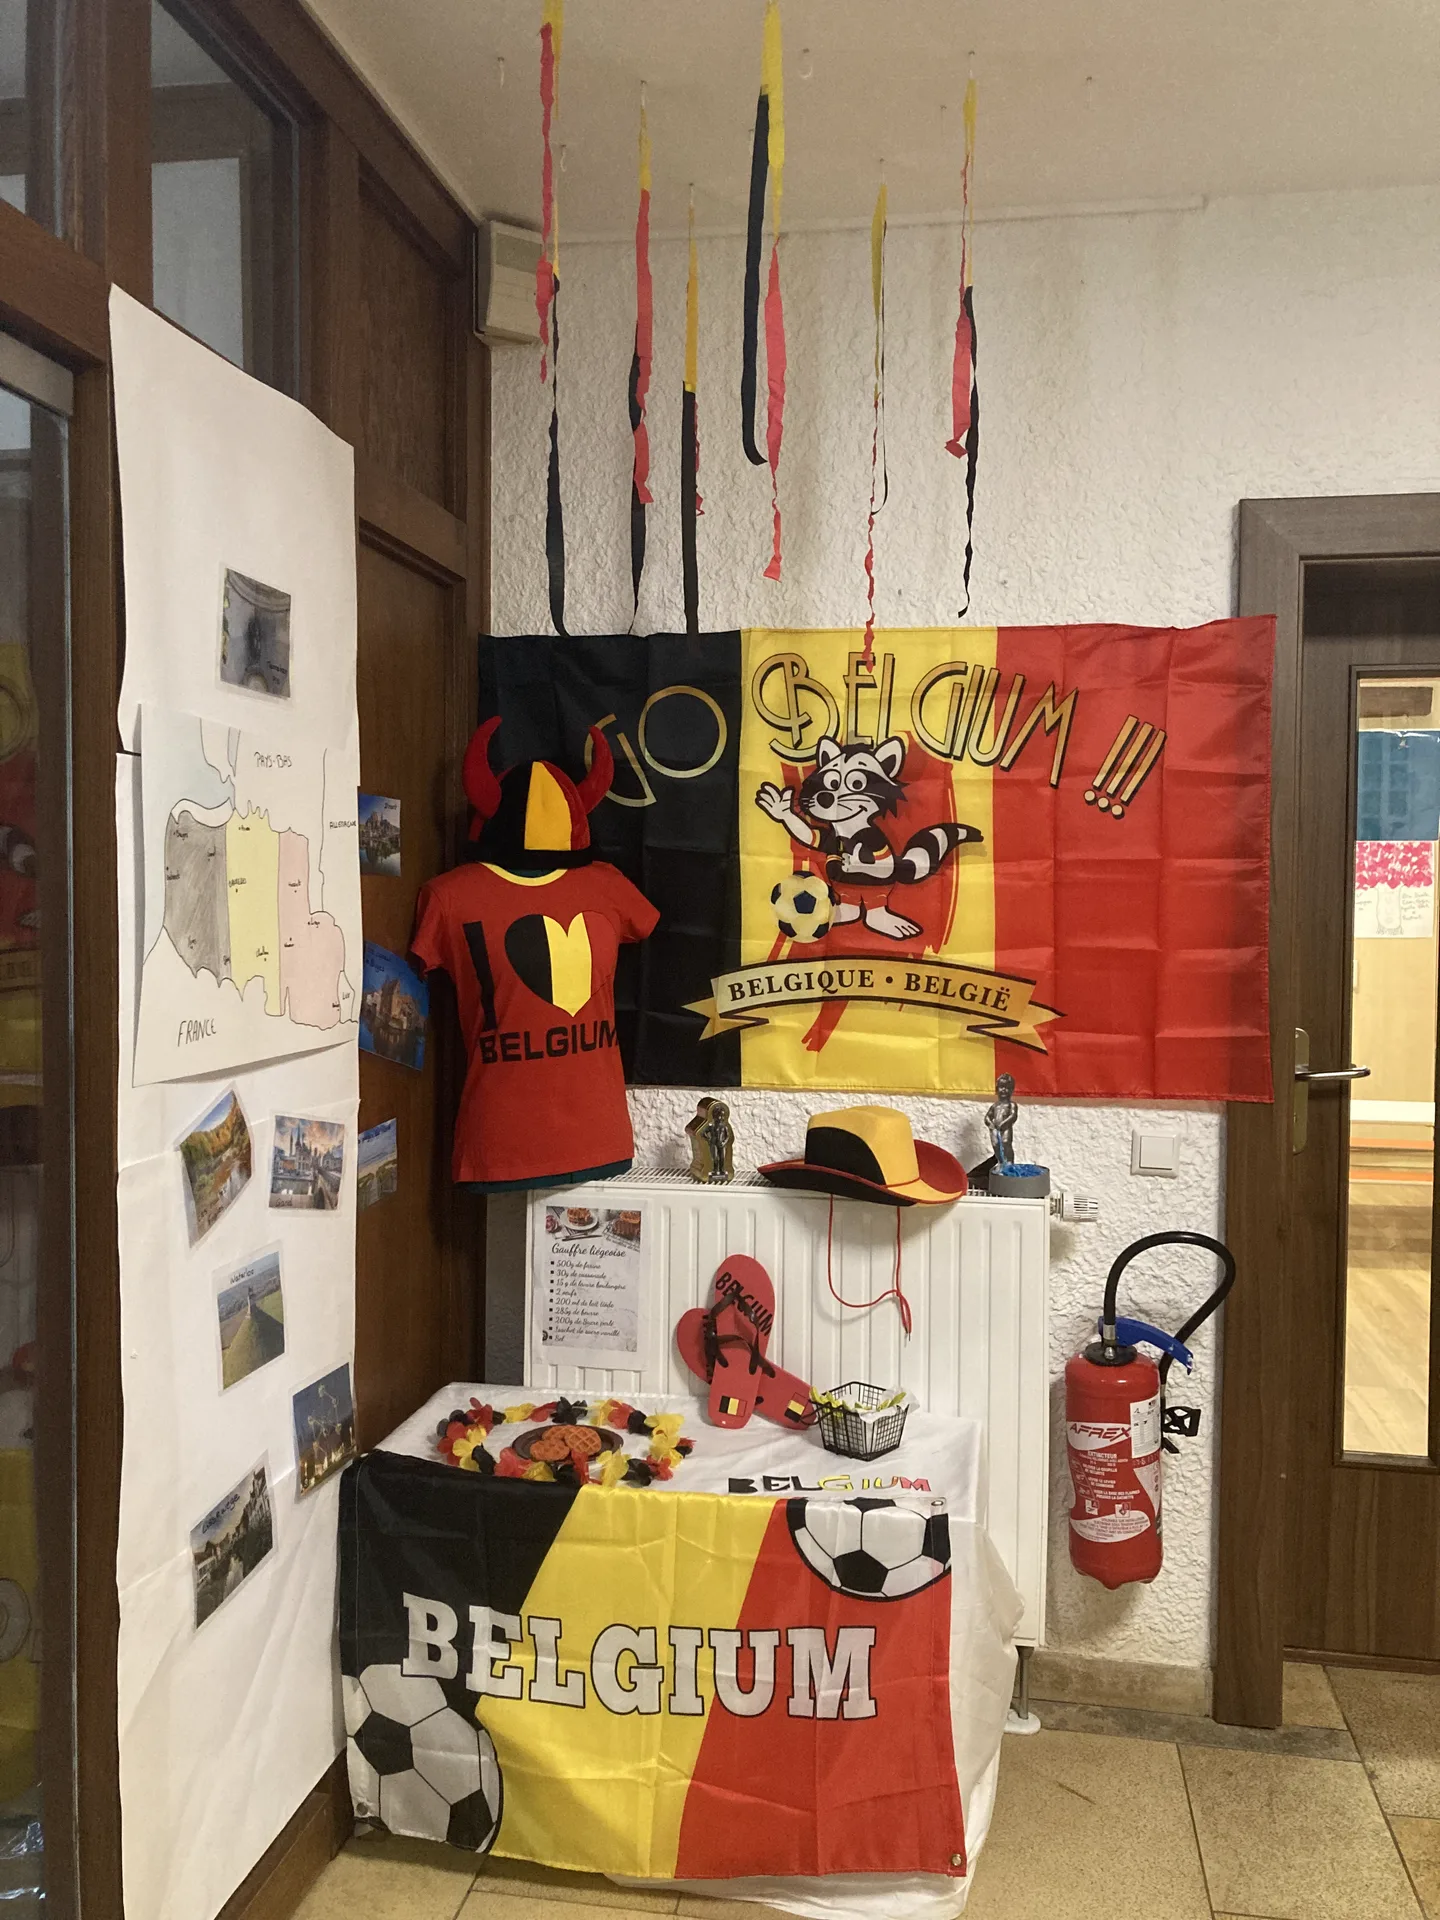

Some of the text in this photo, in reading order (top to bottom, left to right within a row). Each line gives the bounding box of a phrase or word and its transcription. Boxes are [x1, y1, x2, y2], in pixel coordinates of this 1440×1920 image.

[751, 651, 1080, 788] BELGIUM
[254, 751, 293, 768] PAYS-BAS
[462, 920, 498, 1032] I
[728, 968, 1013, 1012] BELGIQUE BELGIË
[177, 1018, 217, 1047] FRANCE
[479, 1019, 619, 1065] BELGIUM
[551, 1242, 626, 1259] Gauffre liégeoise
[1069, 1423, 1132, 1443] AFREX
[728, 1474, 931, 1495] BELGIUM
[399, 1591, 879, 1720] BELGIUM
